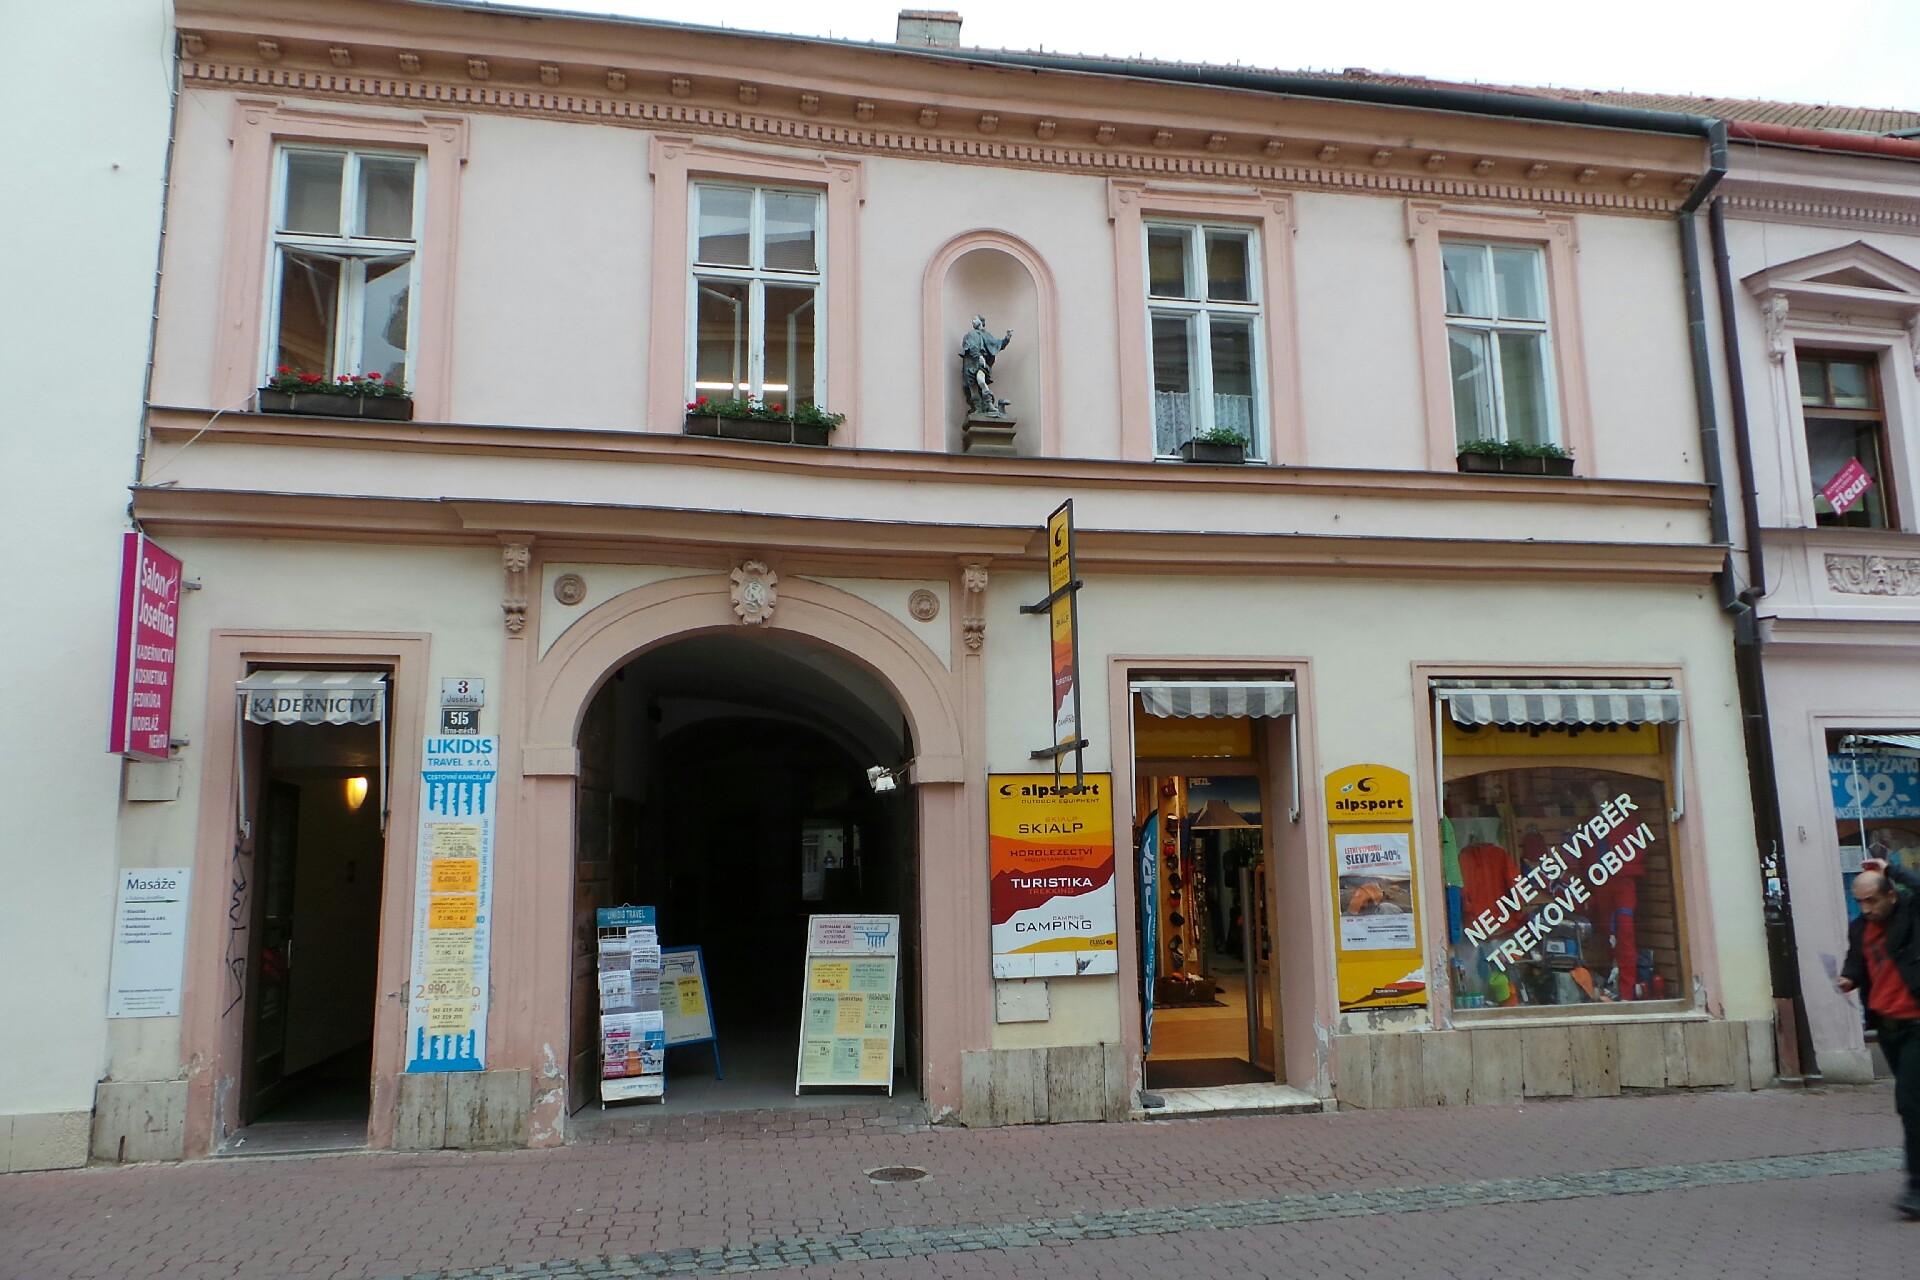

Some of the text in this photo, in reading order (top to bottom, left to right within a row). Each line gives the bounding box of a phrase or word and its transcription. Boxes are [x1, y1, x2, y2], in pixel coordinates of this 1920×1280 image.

[1831, 474, 1868, 516] Fleur
[142, 558, 166, 597] Salon
[135, 668, 167, 685] KOSMETIKA
[458, 681, 468, 693] 3
[133, 690, 160, 708] PEDIKÚRA
[254, 693, 376, 712] KADEŘNICTVÍ
[450, 712, 469, 725] 515
[428, 739, 492, 753] LIKIDIS
[428, 758, 463, 766] TRAVEL
[458, 772, 491, 780] KANCELÁŘ
[1336, 798, 1403, 811] alpsport
[1019, 823, 1083, 834] SKIALP
[1010, 847, 1093, 857] HOROLEZECTVÍ
[1346, 850, 1401, 865] SLEVY 20-40%
[1464, 793, 1639, 947] NEJVĚTŠÍ VÝBĚR
[127, 878, 176, 890] Masáže
[1011, 878, 1093, 888] TURISTIKA
[1486, 822, 1655, 972] TREKOVÉ OBUVI
[626, 909, 645, 918] TRAVEL
[1015, 920, 1092, 932] CAMPING
